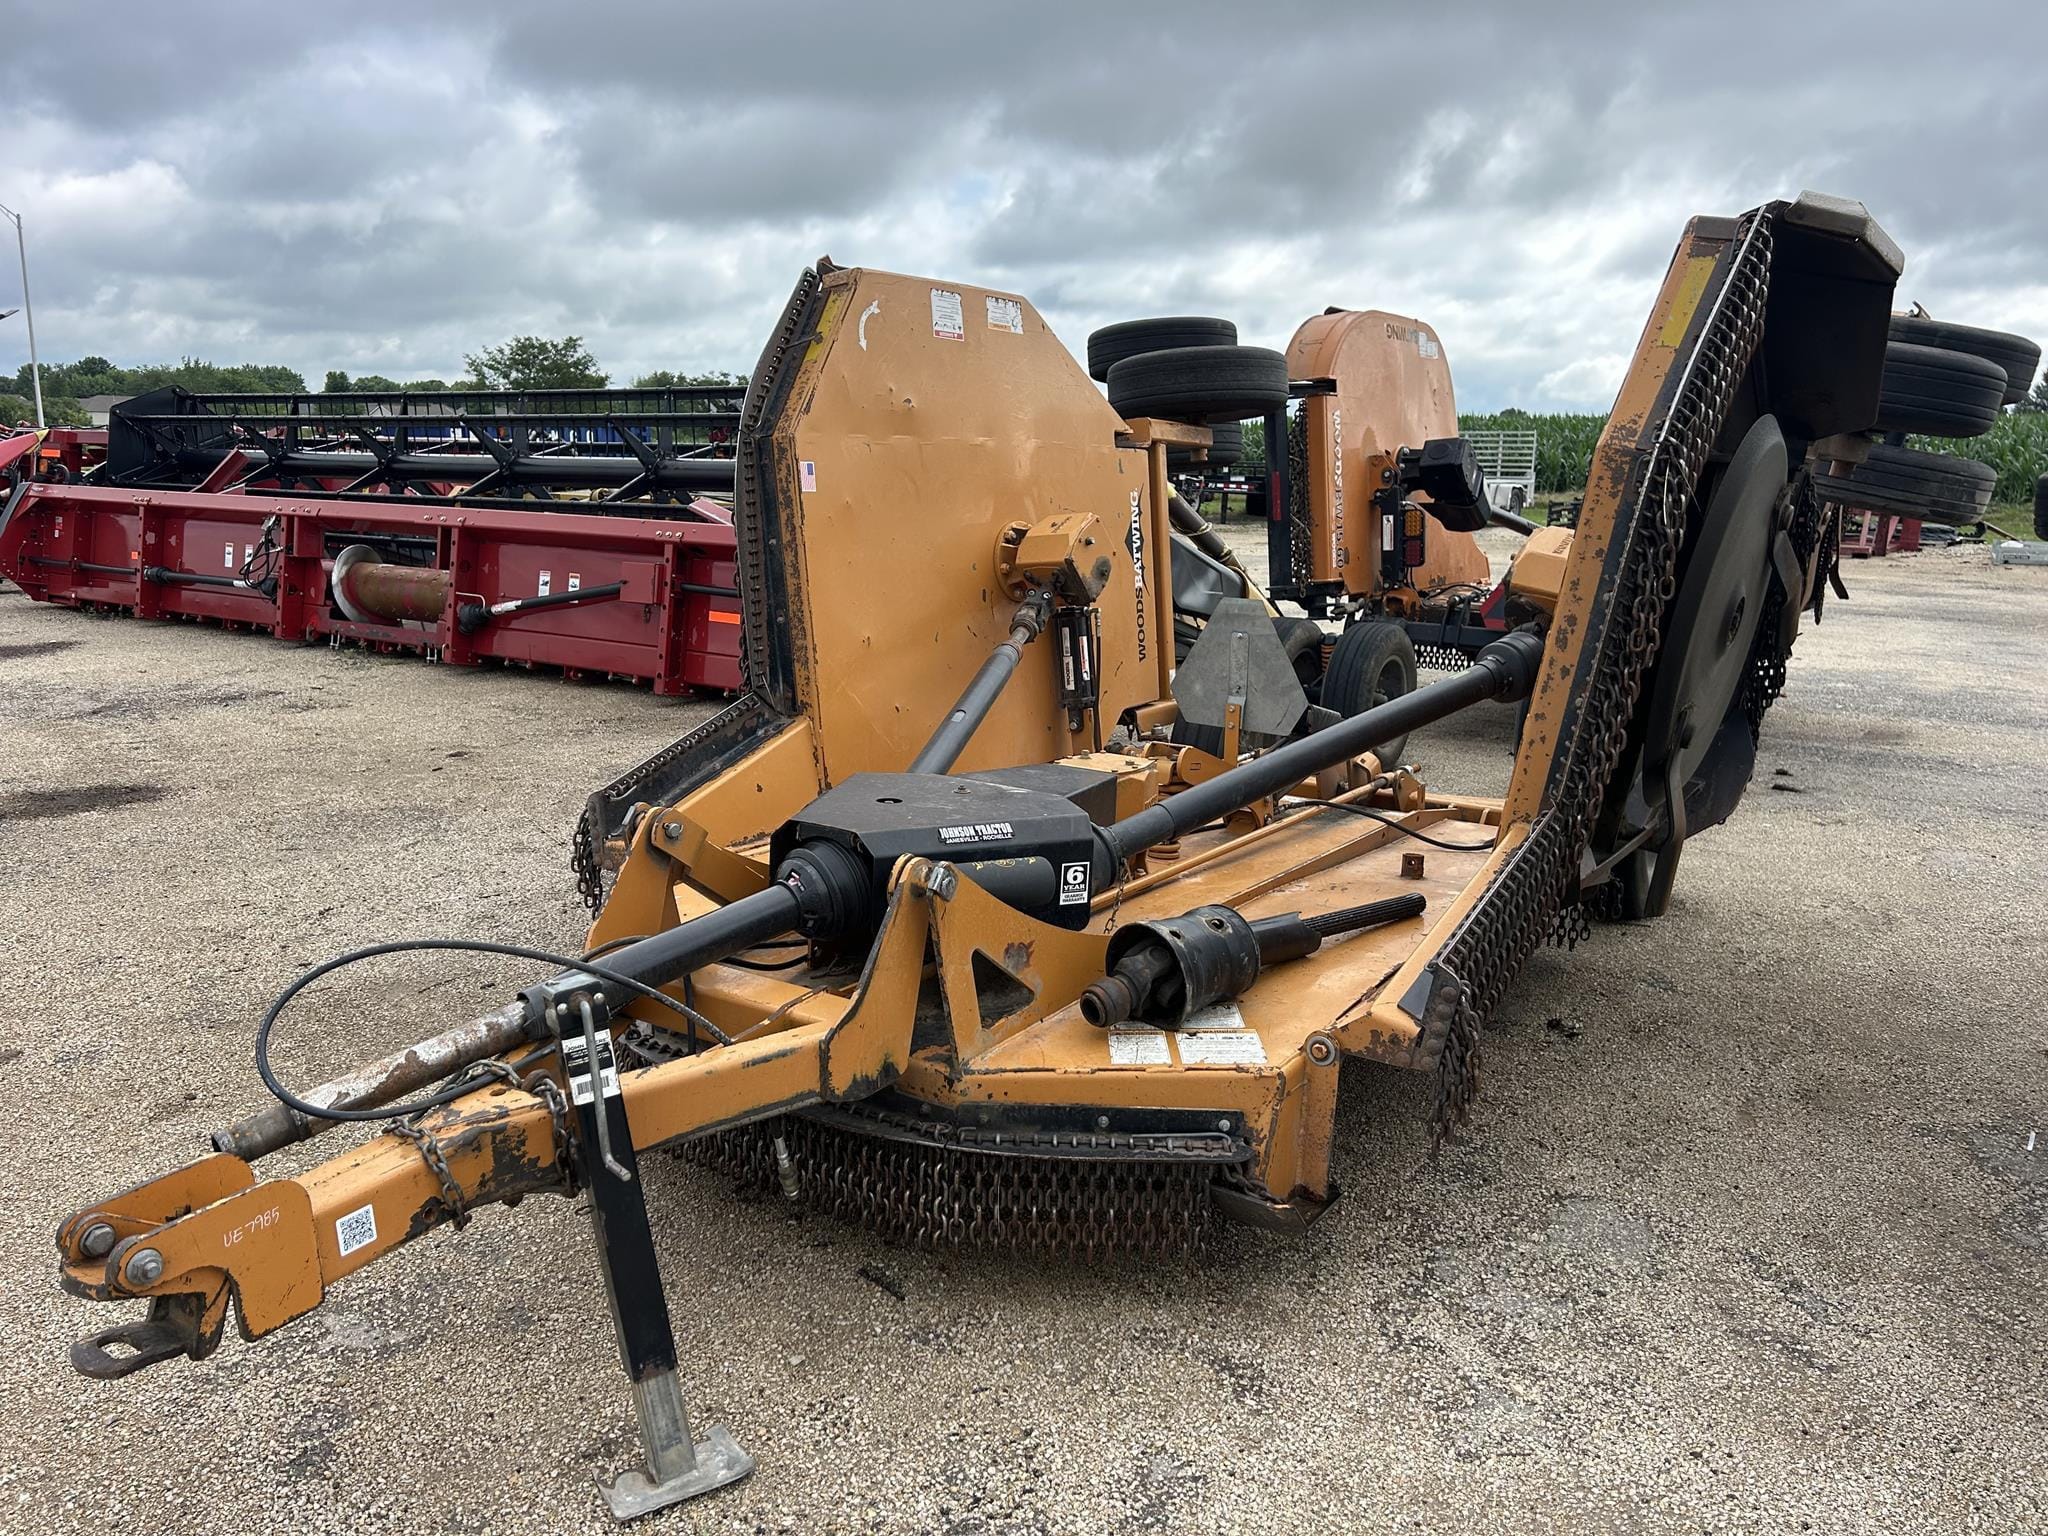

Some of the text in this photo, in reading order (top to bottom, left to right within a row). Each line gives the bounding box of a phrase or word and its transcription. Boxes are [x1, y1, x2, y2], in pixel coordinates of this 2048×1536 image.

[1130, 490, 1146, 662] WOODS BATWING
[939, 822, 1013, 839] JOHNSON TRACTOR
[946, 836, 980, 844] JANESVILLE
[983, 833, 1012, 841] ROCHELLE
[1066, 866, 1085, 884] 6
[244, 1206, 280, 1233] 7985
